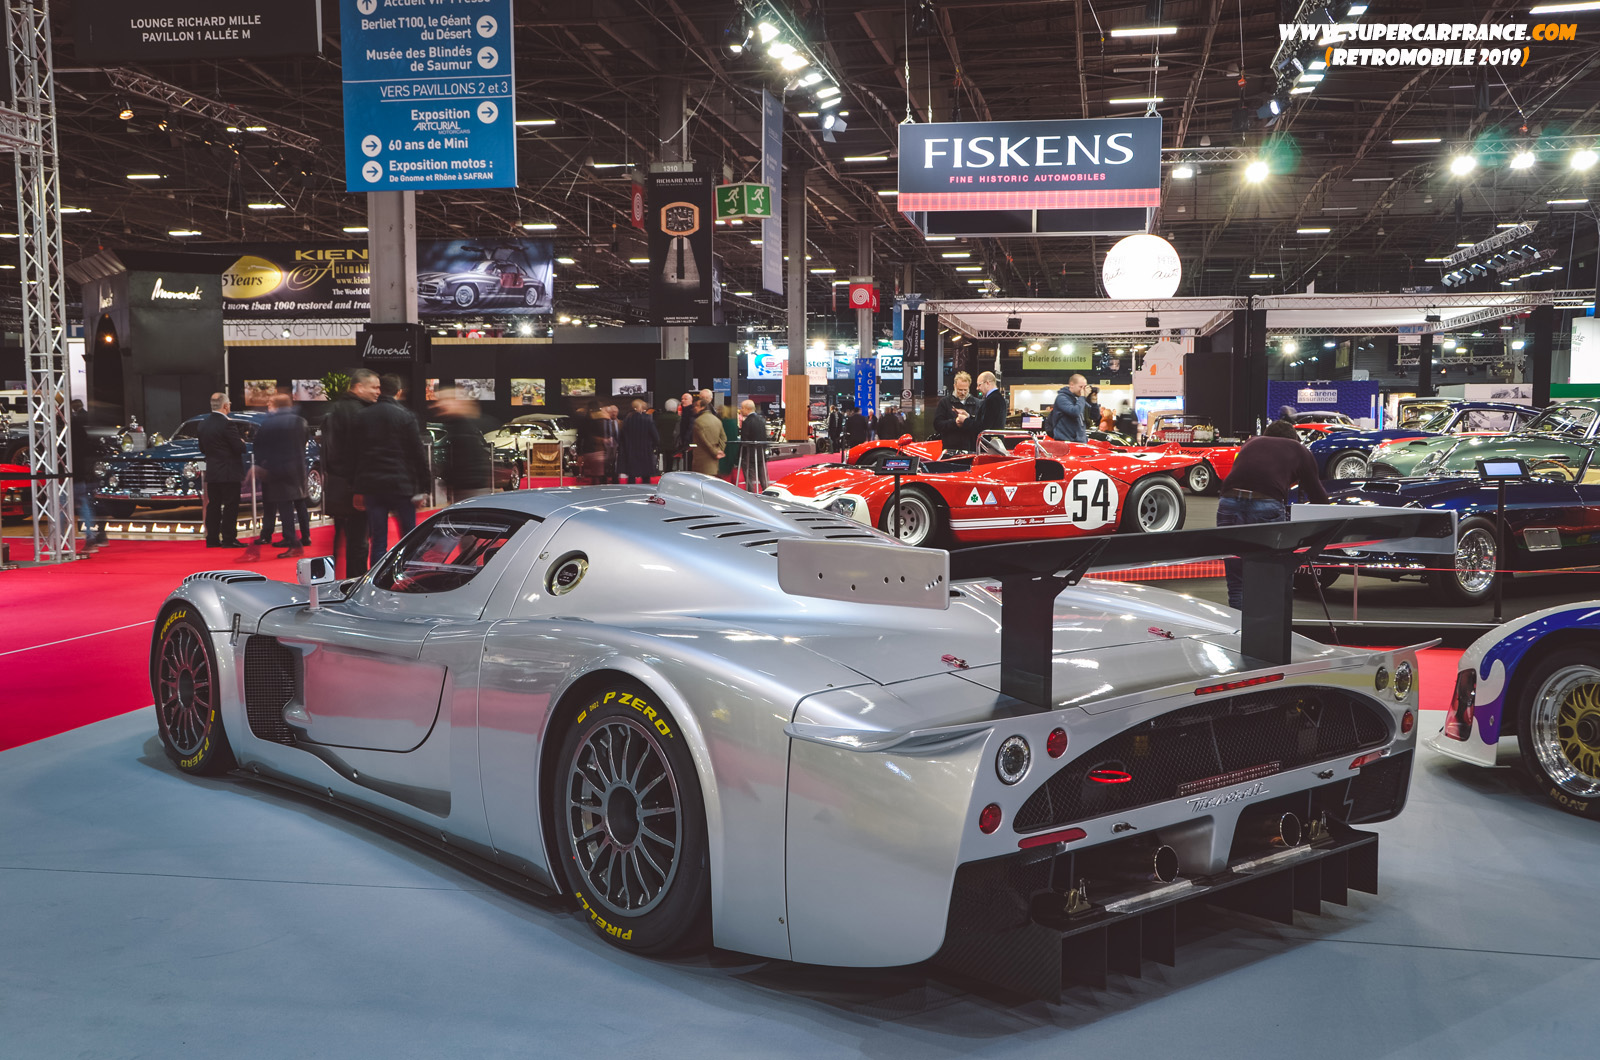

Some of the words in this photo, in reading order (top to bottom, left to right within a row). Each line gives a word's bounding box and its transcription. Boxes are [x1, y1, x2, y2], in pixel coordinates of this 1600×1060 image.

[131, 18, 174, 28] LOUNGE
[177, 16, 226, 27] RICHARD
[229, 15, 261, 25] MILLE
[361, 18, 396, 30] Berliet
[399, 16, 426, 29] T100,
[428, 16, 438, 27] le
[440, 14, 471, 27] Géant
[142, 31, 194, 42] PAVILLON
[197, 31, 202, 40] 1
[205, 28, 239, 40] ALLÉE
[242, 29, 251, 39] M
[421, 30, 434, 40] du
[436, 28, 472, 40] Désert
[366, 48, 402, 60] Musée
[406, 47, 426, 59] des
[429, 45, 472, 58] Blindés
[410, 61, 424, 72] de
[427, 60, 472, 71] Saumur
[380, 85, 410, 98] VERS
[413, 83, 476, 96] PAVILLONS
[478, 82, 485, 94] 2
[488, 82, 499, 94] et
[501, 81, 508, 93] 3
[411, 109, 470, 123] Exposition
[413, 121, 461, 131] ARTCURIAL
[388, 139, 402, 151] 60
[405, 139, 425, 150] ans
[427, 138, 441, 150] de
[444, 137, 469, 149] Mini
[924, 133, 1134, 168] FISKENS
[389, 159, 448, 173] Exposition
[451, 158, 486, 170] motos
[389, 174, 399, 182] De
[400, 174, 425, 182] Gnome
[434, 172, 456, 181] Rhône
[458, 171, 462, 180] à
[463, 172, 494, 180] SAFRAN
[979, 175, 1029, 183] HISTORIC
[1034, 173, 1106, 182] AUTOMOBILES
[151, 277, 203, 301] Movendi
[228, 303, 249, 311] more
[251, 301, 271, 310] than
[274, 301, 295, 310] 1000
[297, 301, 333, 310] restored
[335, 301, 351, 310] and
[363, 334, 411, 357] Movendi
[1050, 486, 1057, 502] P
[1072, 478, 1110, 522] 54
[603, 691, 616, 704] P
[618, 692, 671, 736] ZERO
[1186, 781, 1270, 813] Maserati
[575, 891, 633, 940] PIRELLI
